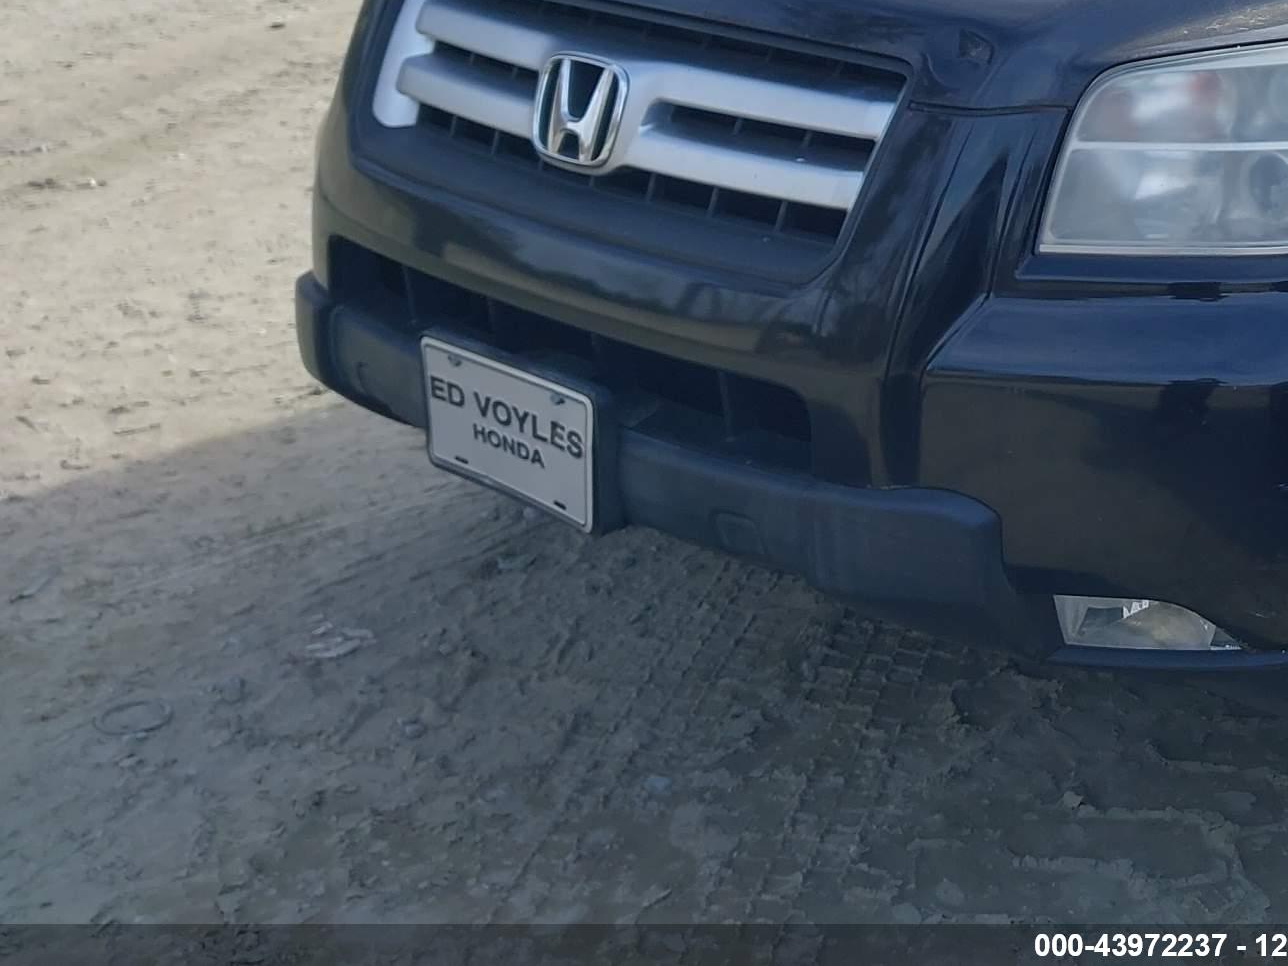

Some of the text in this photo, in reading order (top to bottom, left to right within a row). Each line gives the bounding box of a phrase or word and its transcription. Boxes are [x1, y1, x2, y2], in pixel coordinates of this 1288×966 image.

[429, 375, 585, 460] ED VOYLES
[472, 423, 546, 469] HONDA
